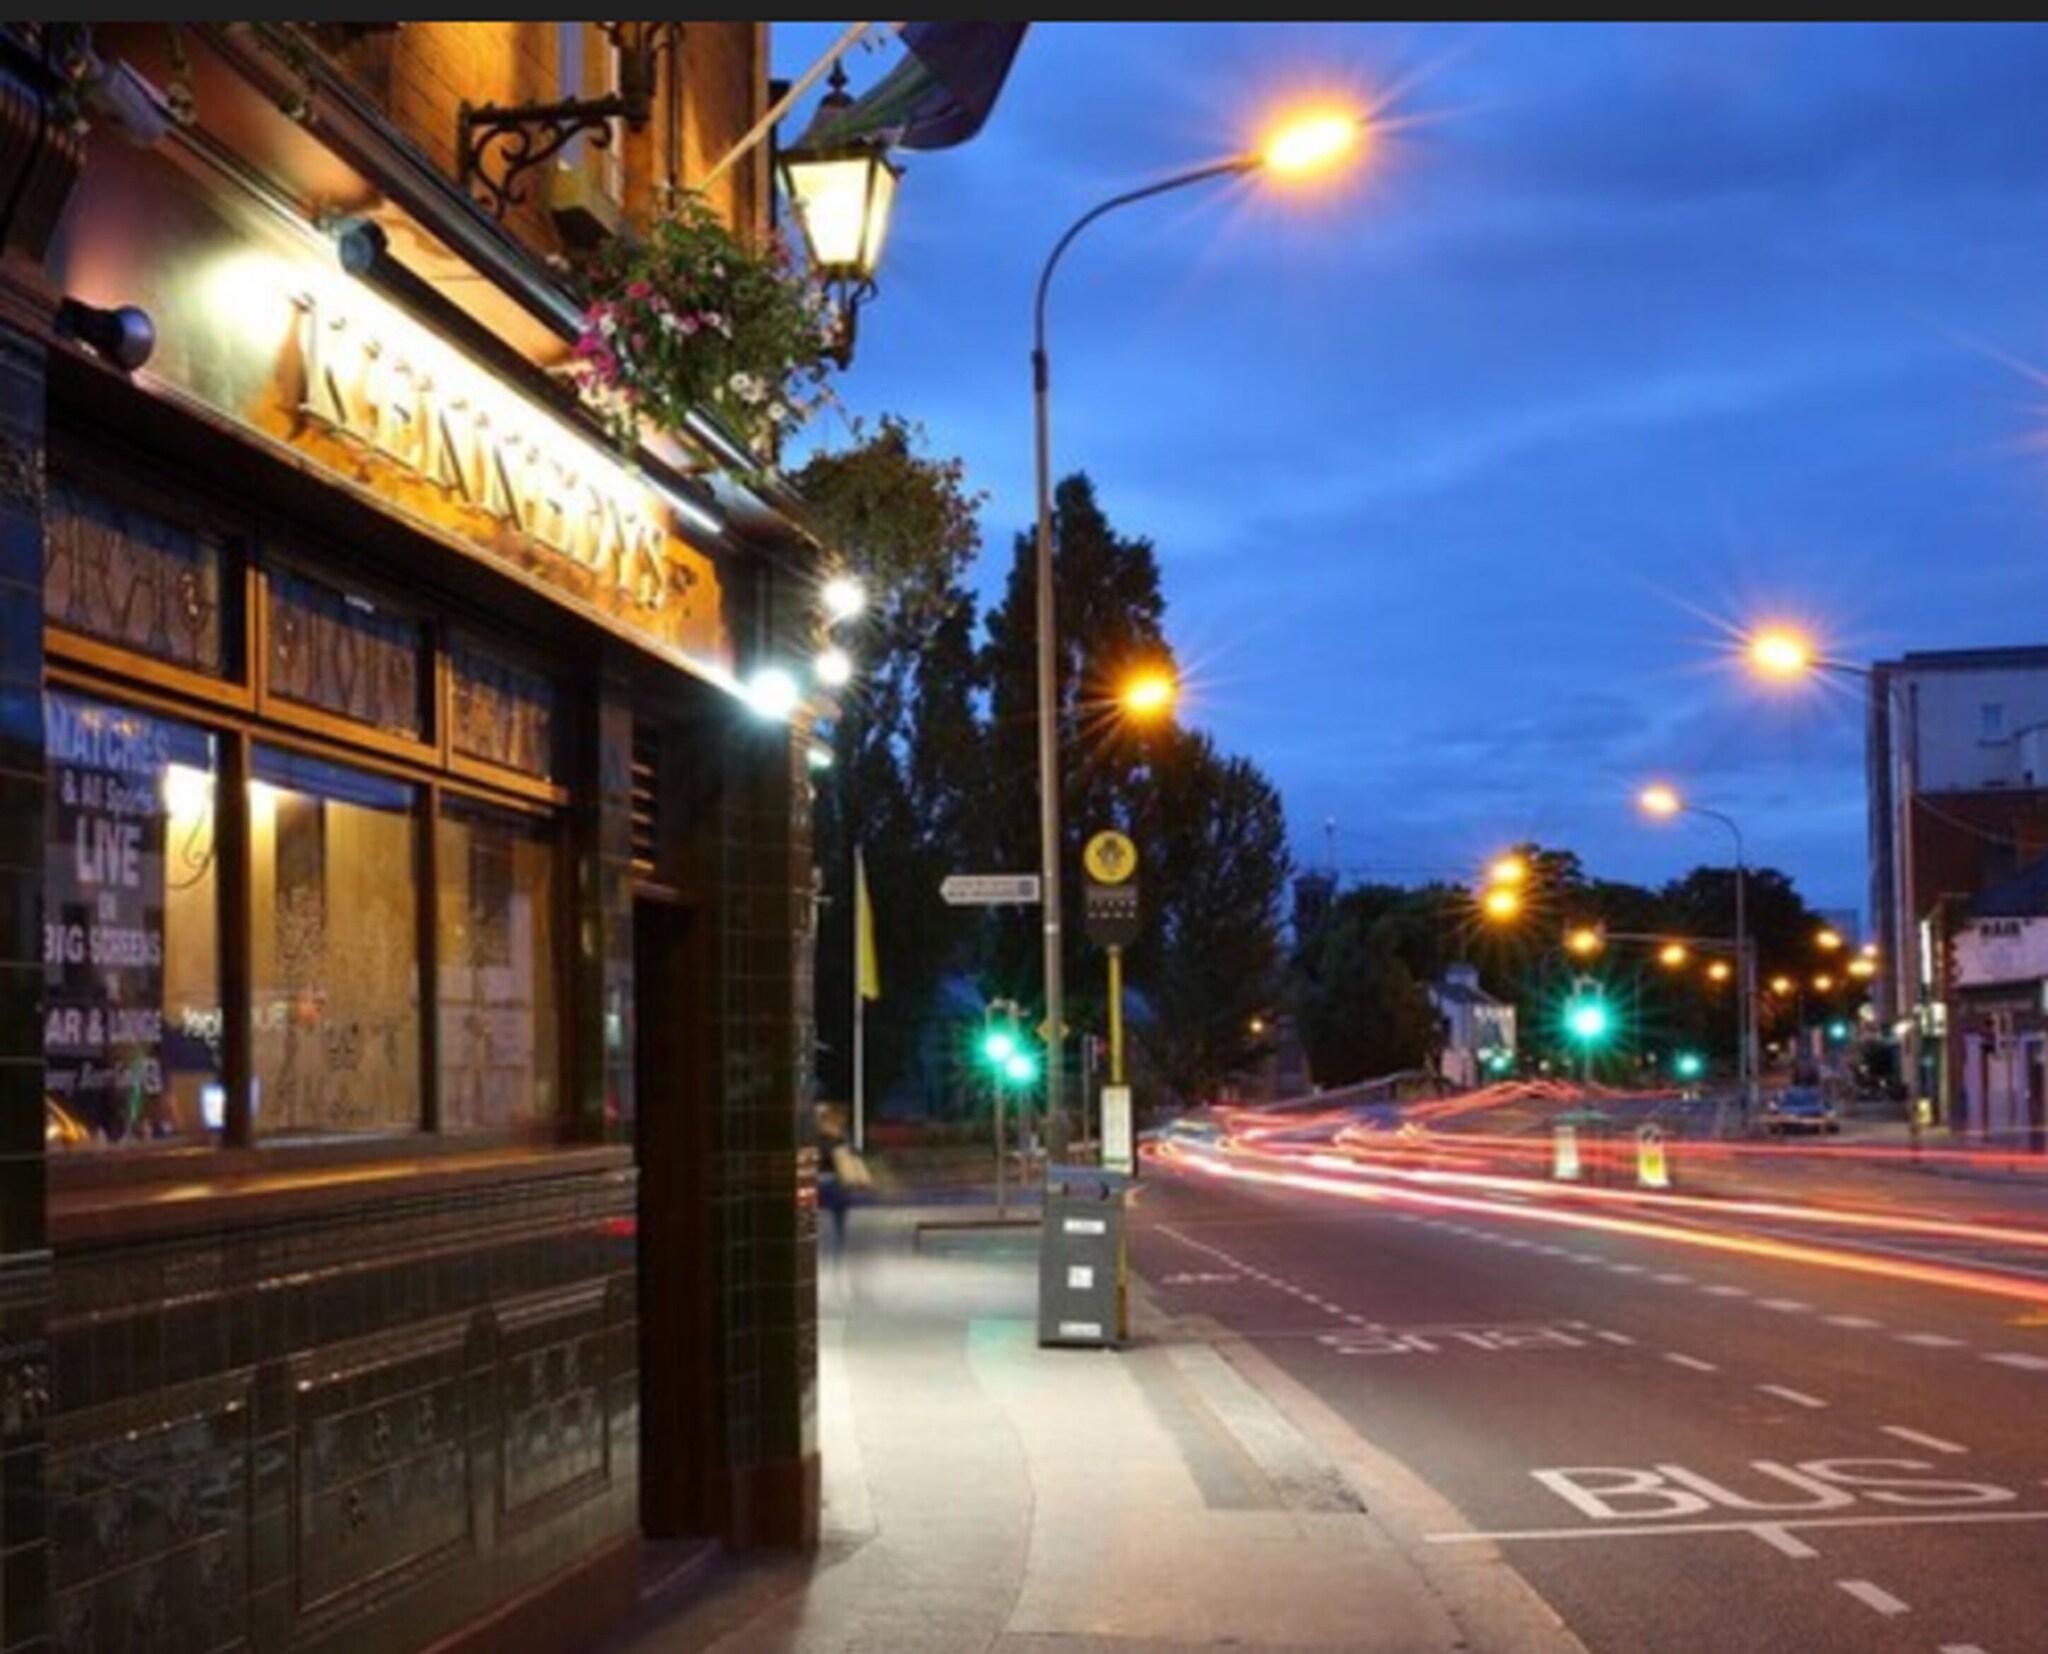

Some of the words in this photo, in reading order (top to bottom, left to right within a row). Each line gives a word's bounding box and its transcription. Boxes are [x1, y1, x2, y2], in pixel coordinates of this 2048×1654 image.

[77, 815, 142, 887] LIVE
[44, 924, 84, 965] BIG
[44, 1006, 80, 1045] AR
[1529, 1457, 2018, 1520] BUS
